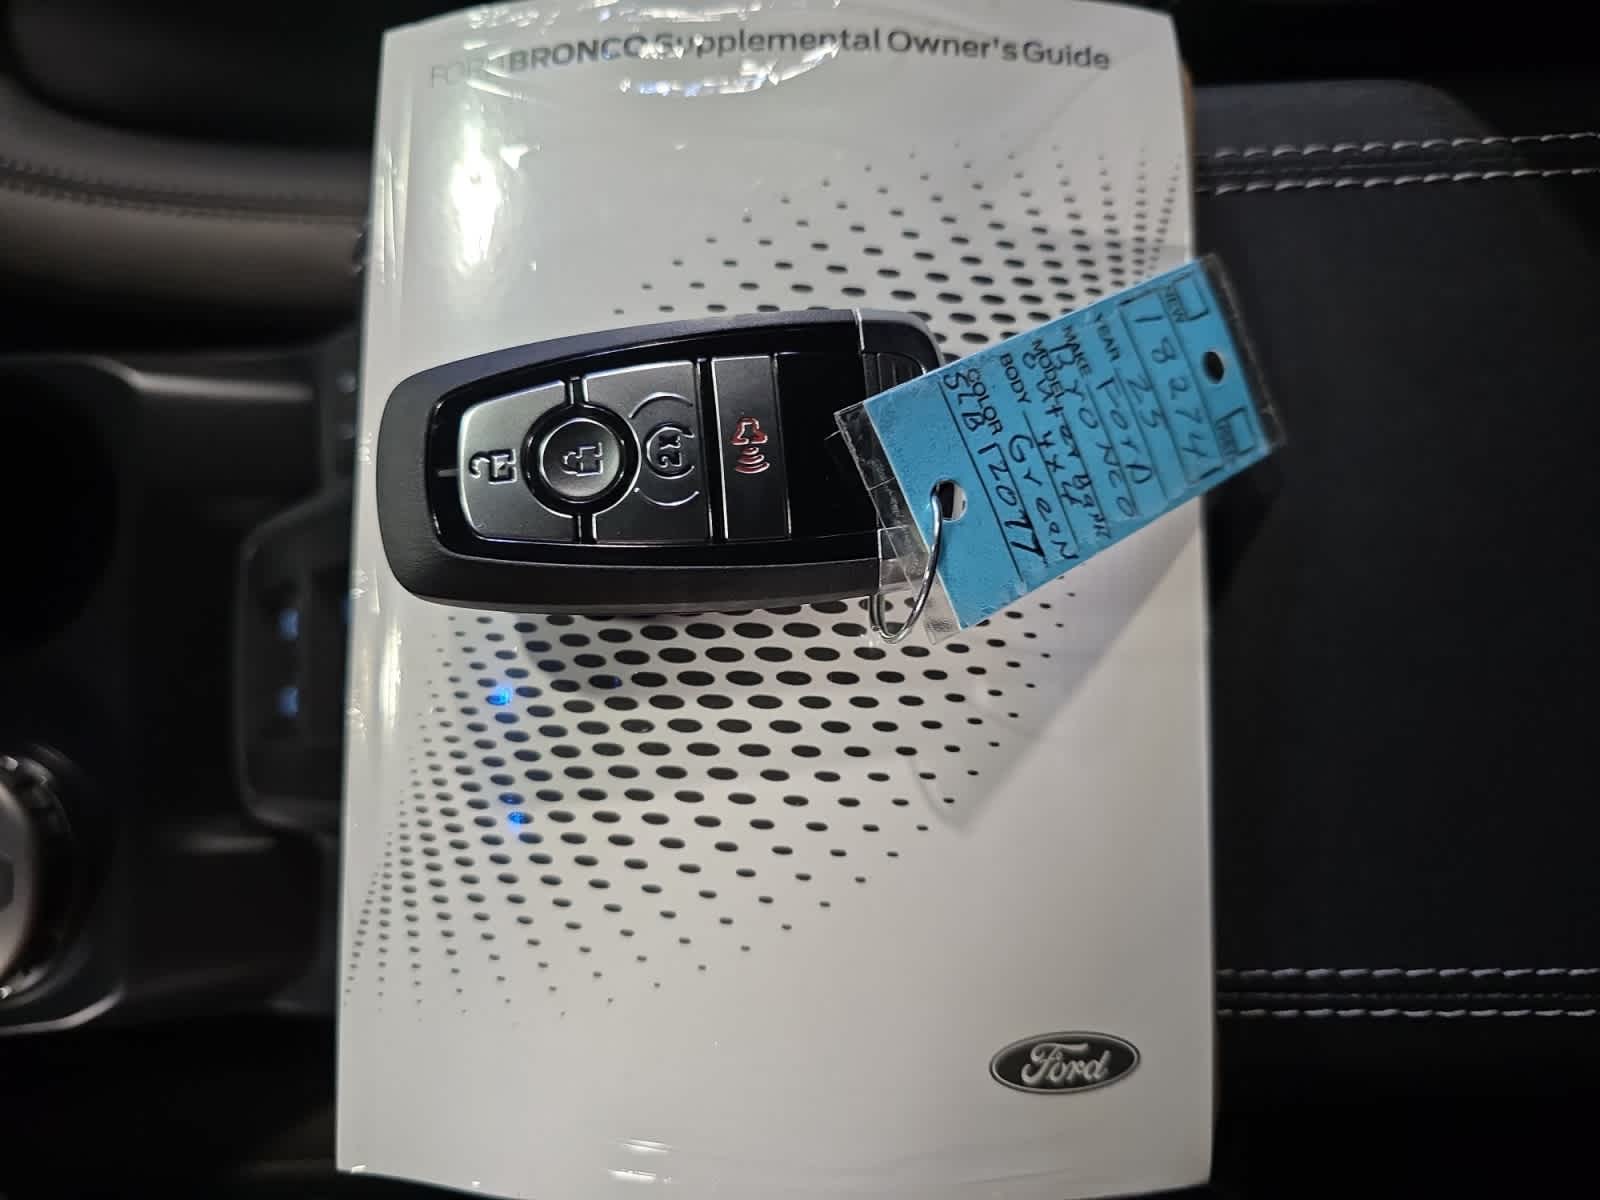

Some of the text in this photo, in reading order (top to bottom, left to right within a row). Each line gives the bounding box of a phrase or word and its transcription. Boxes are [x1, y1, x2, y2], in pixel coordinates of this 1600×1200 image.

[510, 34, 648, 72] BRONCO
[655, 28, 880, 59] Supplemental
[887, 29, 1018, 62] Owner's
[1022, 40, 1110, 71] Guide
[1062, 325, 1093, 377] MAKE
[1094, 314, 1120, 362] YEAR
[1000, 353, 1032, 404] BODY
[1032, 338, 1066, 400] MODEL
[1134, 315, 1207, 458] 18274
[966, 368, 1004, 436] COLOR
[1021, 1042, 1112, 1084] Ford
